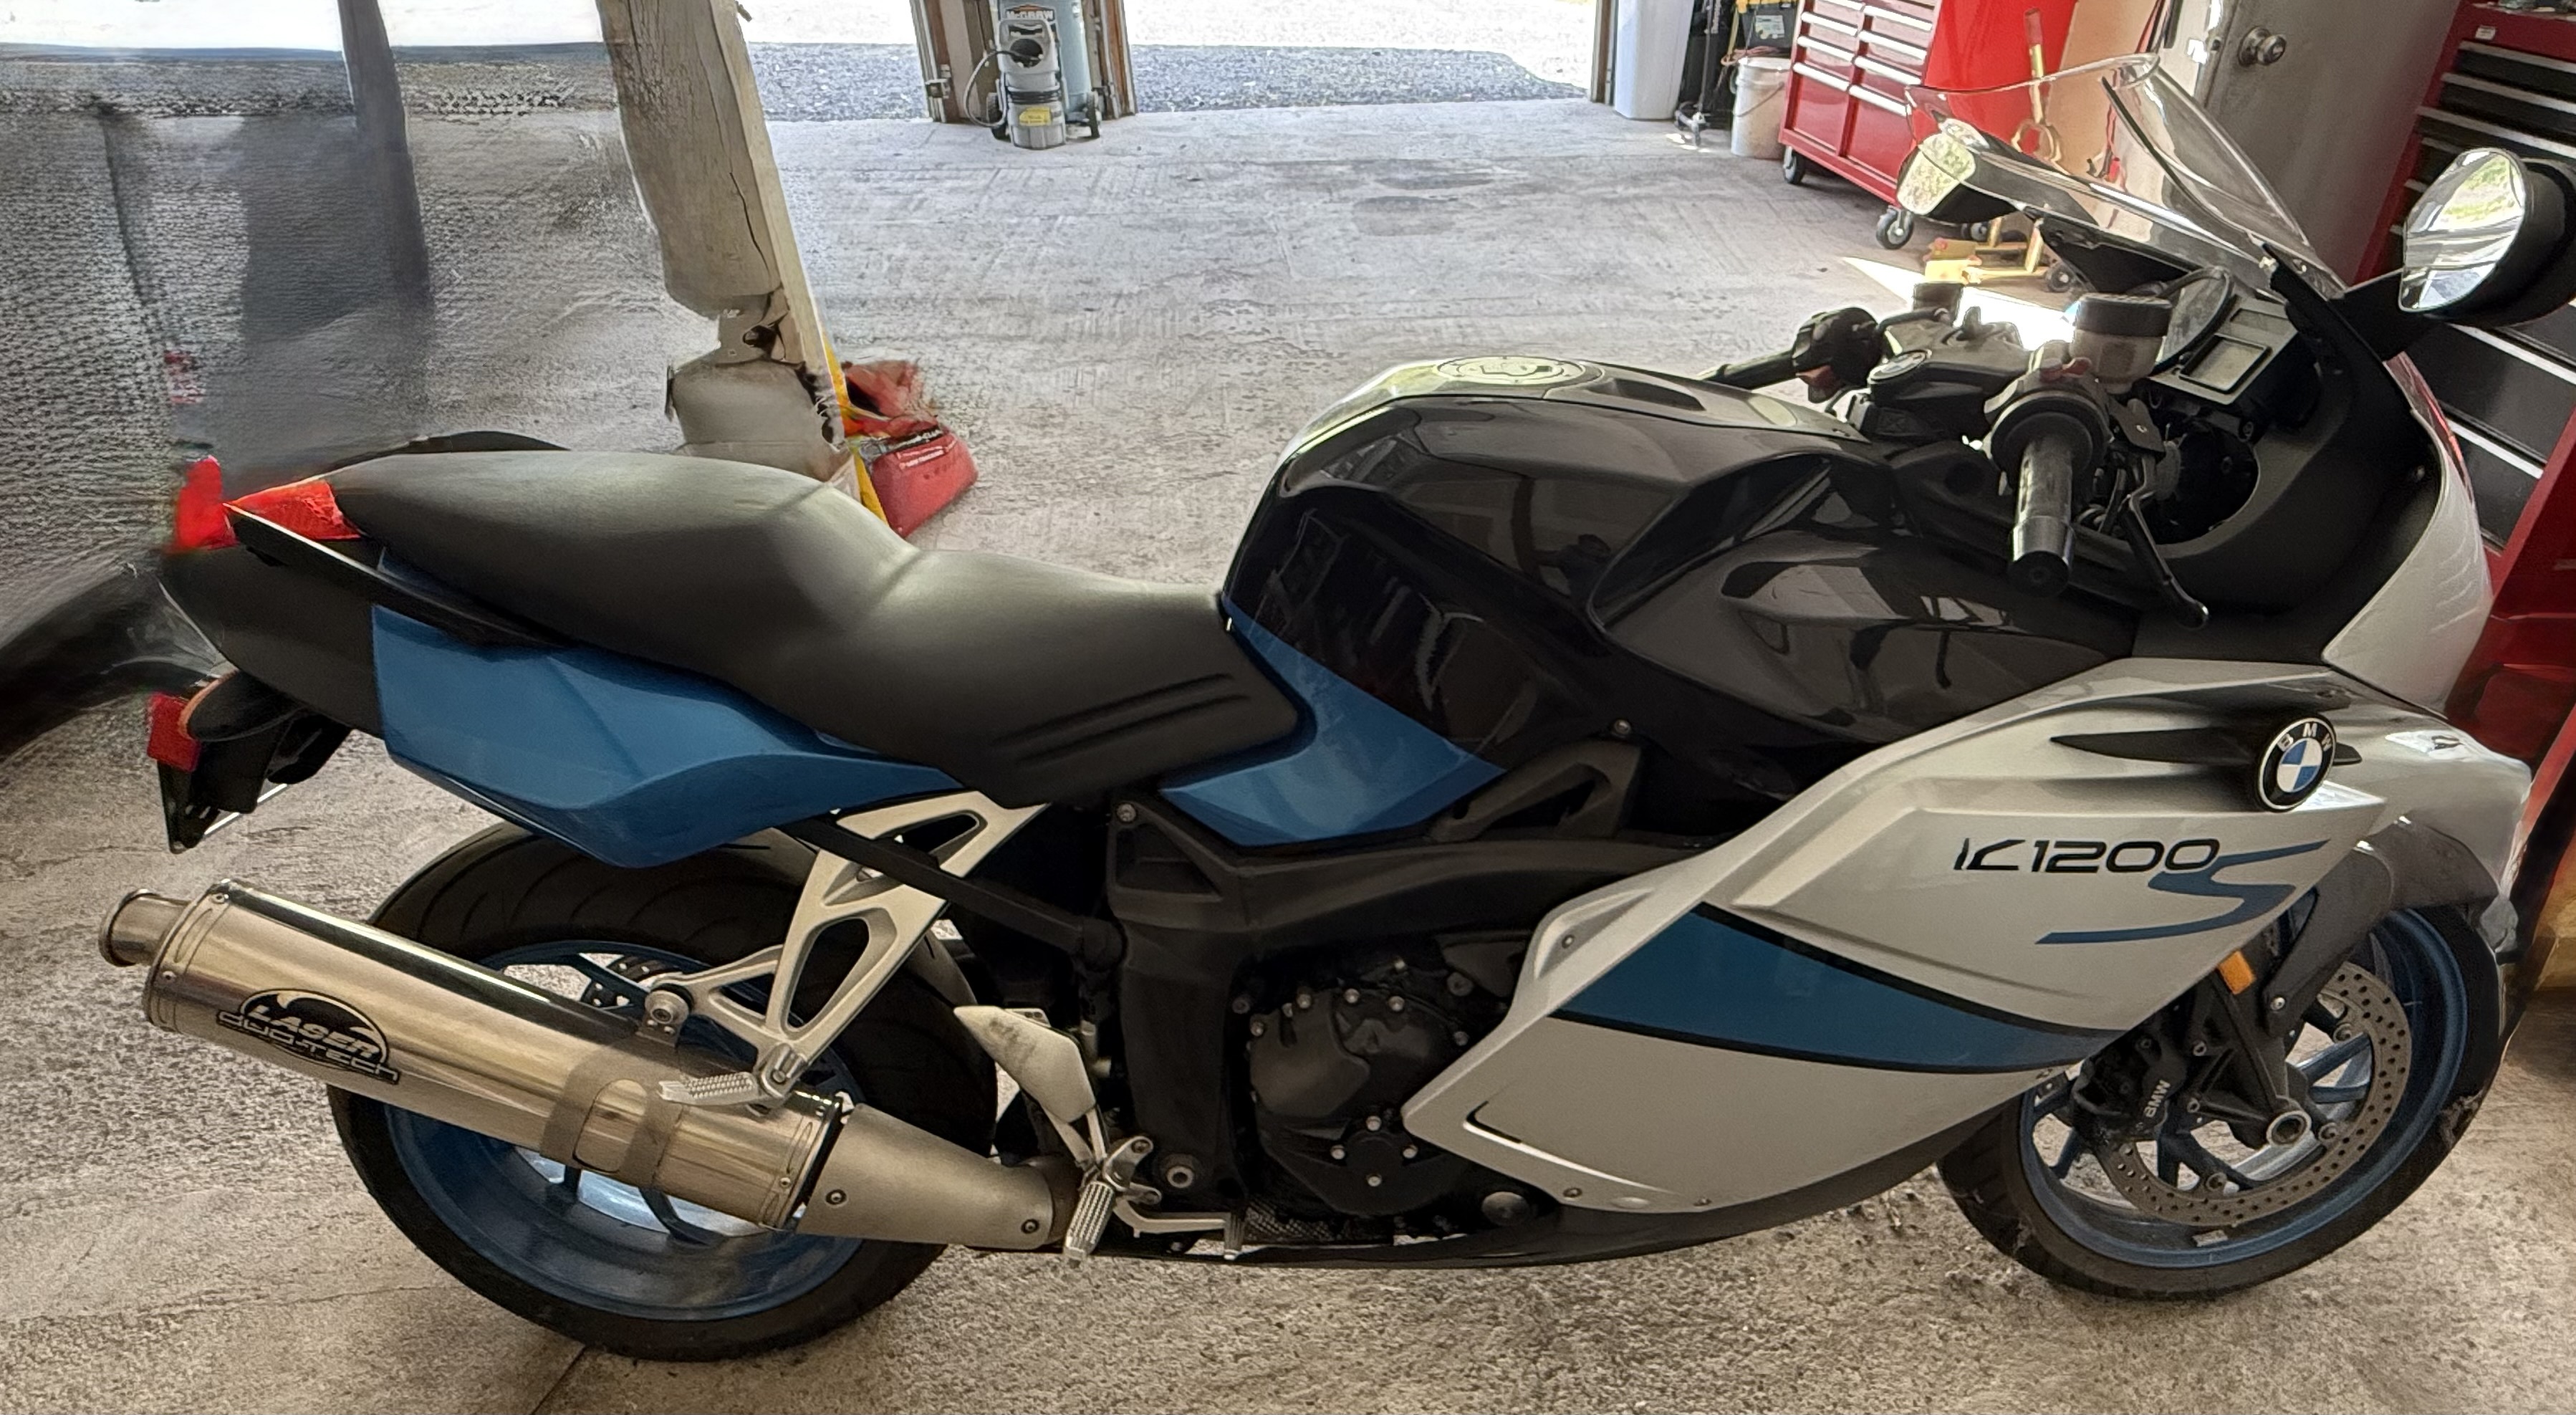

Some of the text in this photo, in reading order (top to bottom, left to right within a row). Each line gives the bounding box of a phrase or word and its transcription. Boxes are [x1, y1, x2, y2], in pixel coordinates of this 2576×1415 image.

[2277, 723, 2332, 752] BMW
[1953, 838, 2220, 873] K1200
[248, 1004, 381, 1059] LASER
[2143, 1080, 2171, 1118] BMW
